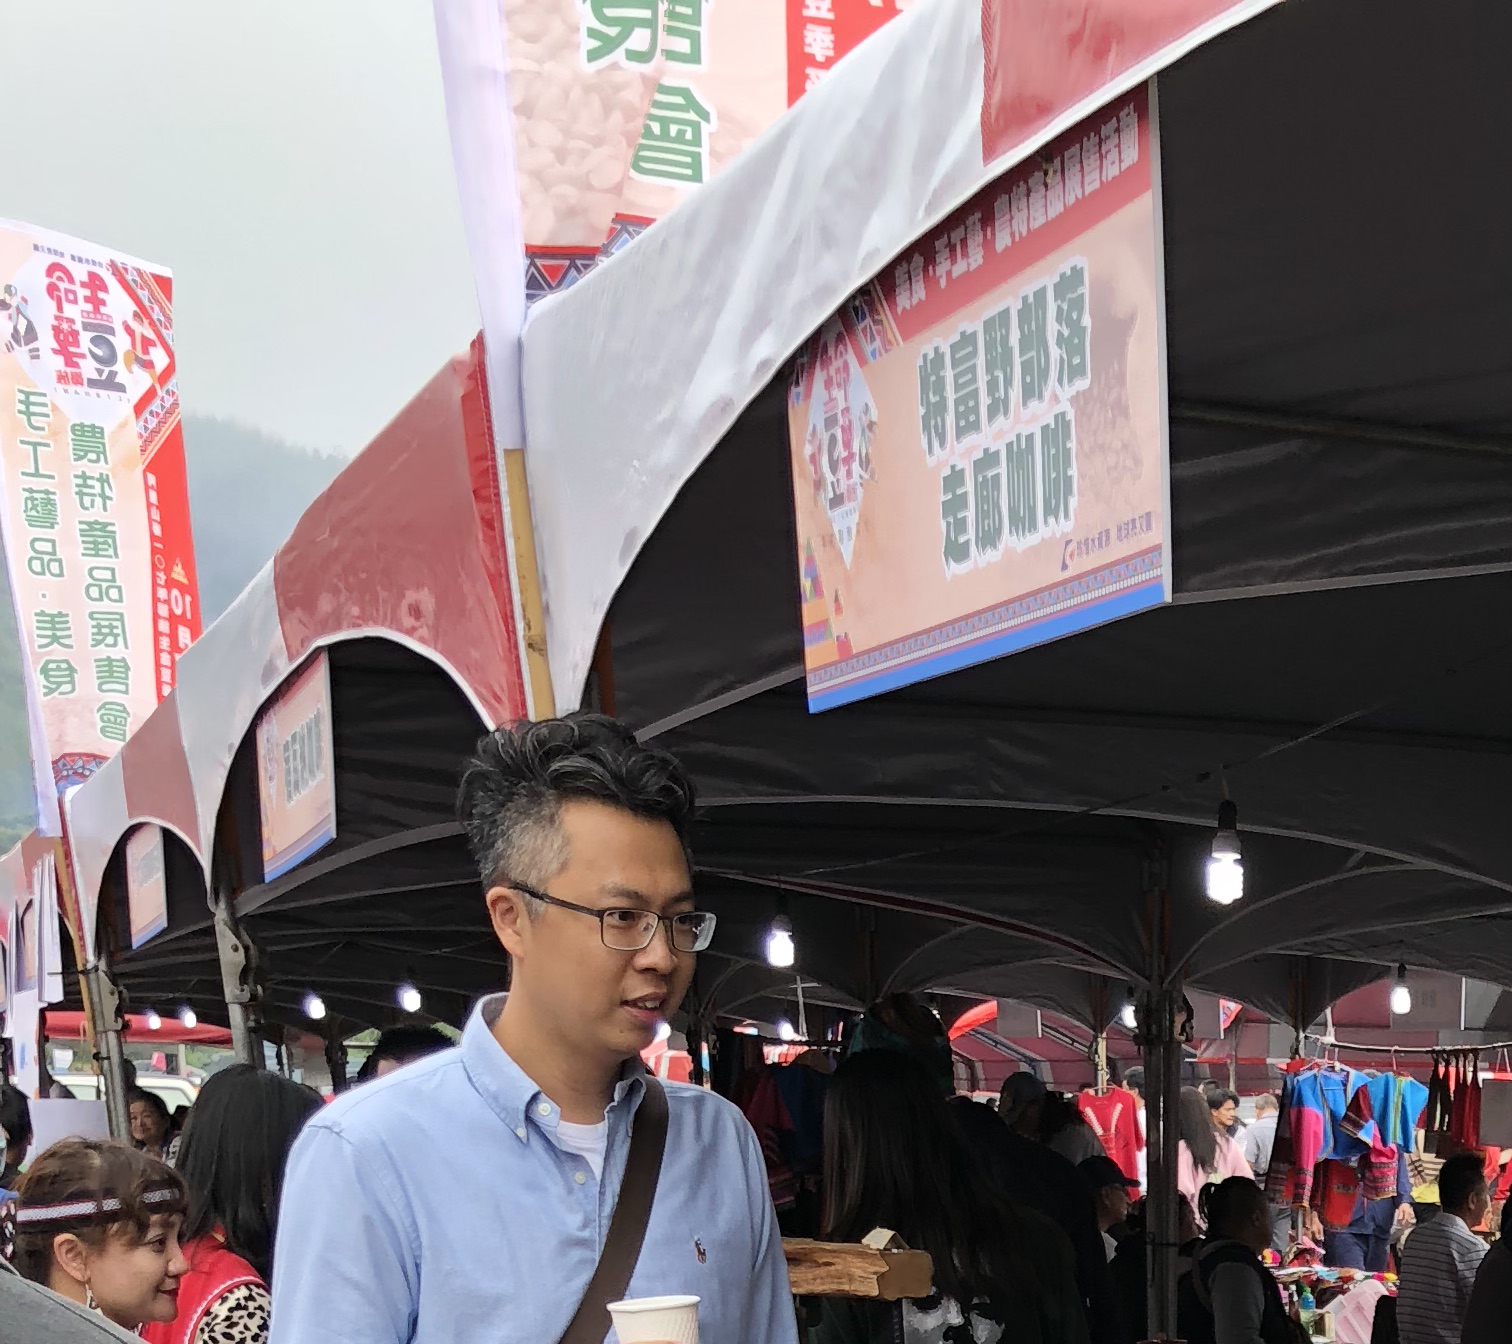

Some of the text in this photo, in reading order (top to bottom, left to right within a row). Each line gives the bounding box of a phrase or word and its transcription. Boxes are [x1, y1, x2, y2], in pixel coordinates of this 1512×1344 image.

[919, 264, 1088, 457] 特富野部落
[941, 411, 1075, 569] 走廊咖啡
